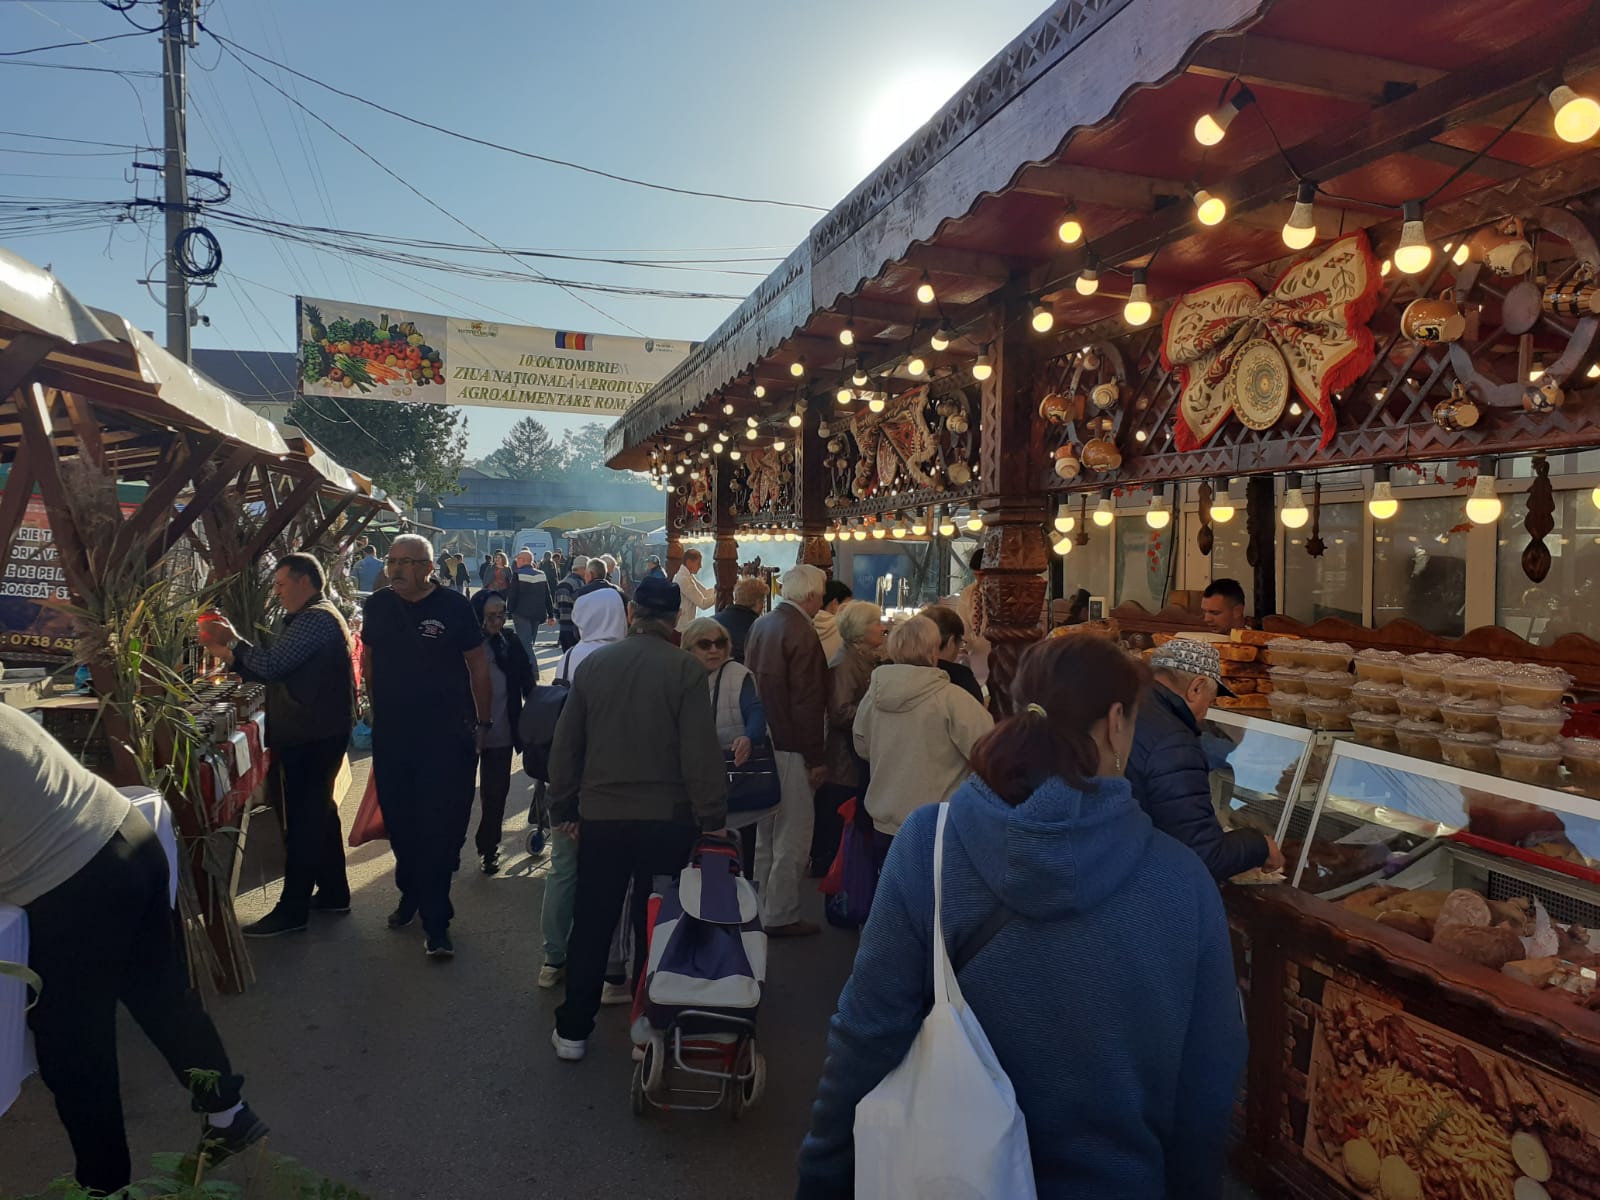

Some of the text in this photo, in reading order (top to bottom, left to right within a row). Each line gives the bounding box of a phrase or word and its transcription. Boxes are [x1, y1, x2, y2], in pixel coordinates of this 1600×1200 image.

[518, 354, 618, 374] 10 OCTOMBRIE
[453, 366, 490, 381] ZIUA
[493, 369, 577, 389] NAȚIONALĂ
[576, 377, 588, 389] A
[457, 385, 593, 408] AGROALIMENTARE
[18, 528, 40, 540] RIE
[17, 565, 36, 578] DE
[38, 566, 54, 580] PE
[10, 634, 50, 647] 0738
